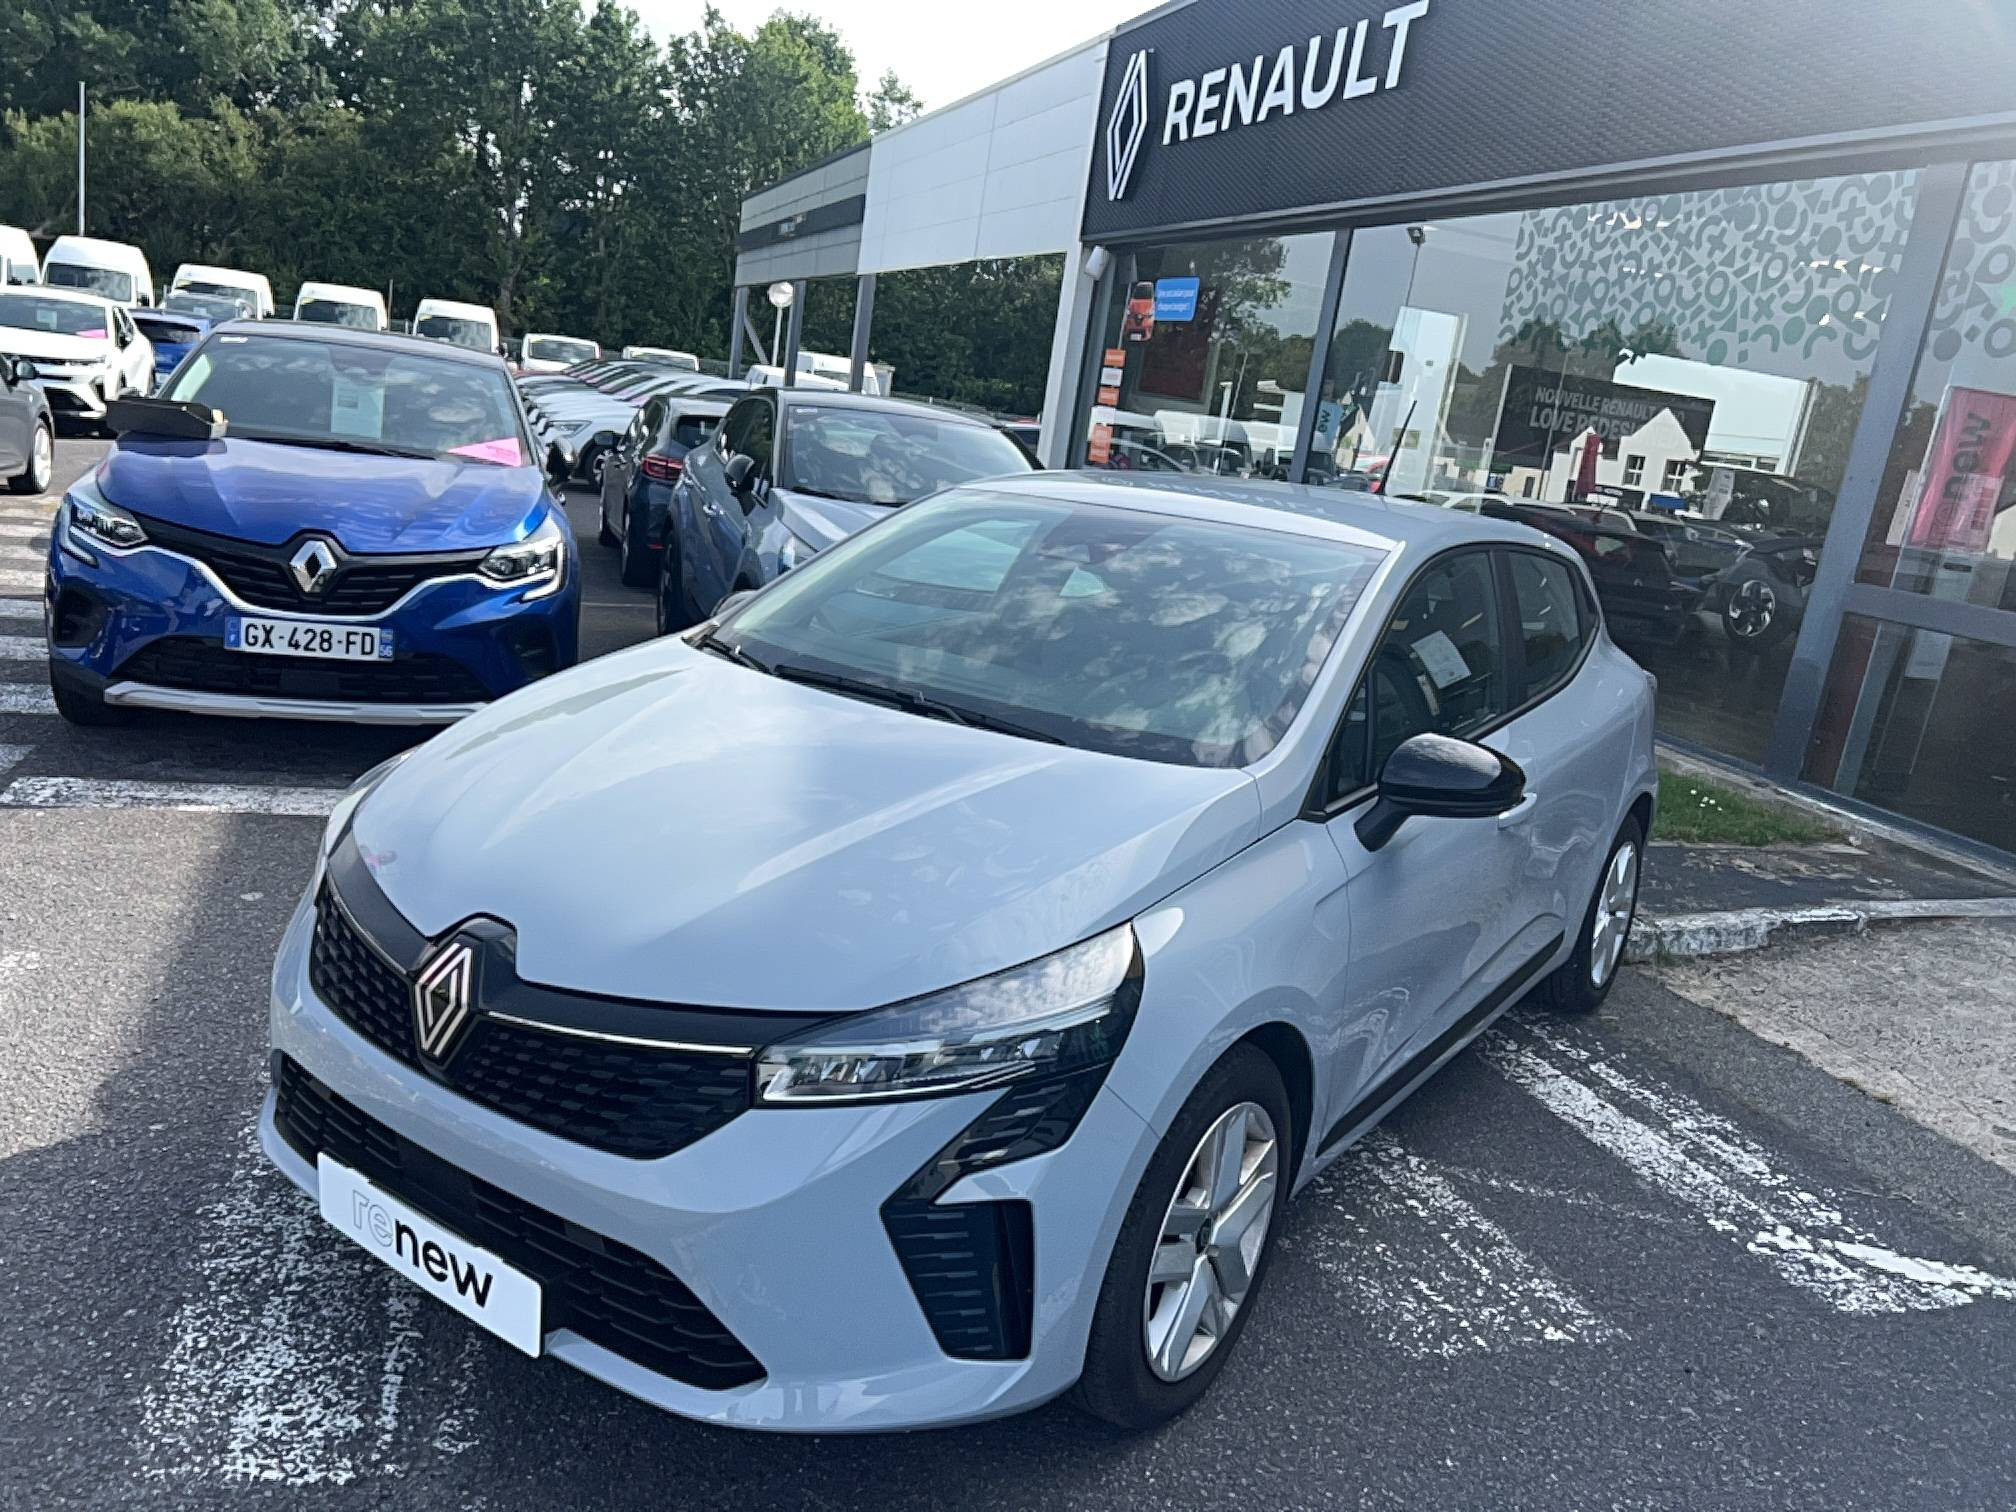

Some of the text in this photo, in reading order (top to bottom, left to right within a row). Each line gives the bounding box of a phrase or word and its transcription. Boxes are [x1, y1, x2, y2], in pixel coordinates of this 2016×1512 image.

[1161, 0, 1429, 145] RENAULT
[1528, 405, 1576, 434] LOVE
[1535, 386, 1600, 414] NOUVELLE
[1601, 398, 1657, 421] RENAULT
[244, 623, 375, 656] GX-428-FD
[352, 1190, 493, 1308] renew
